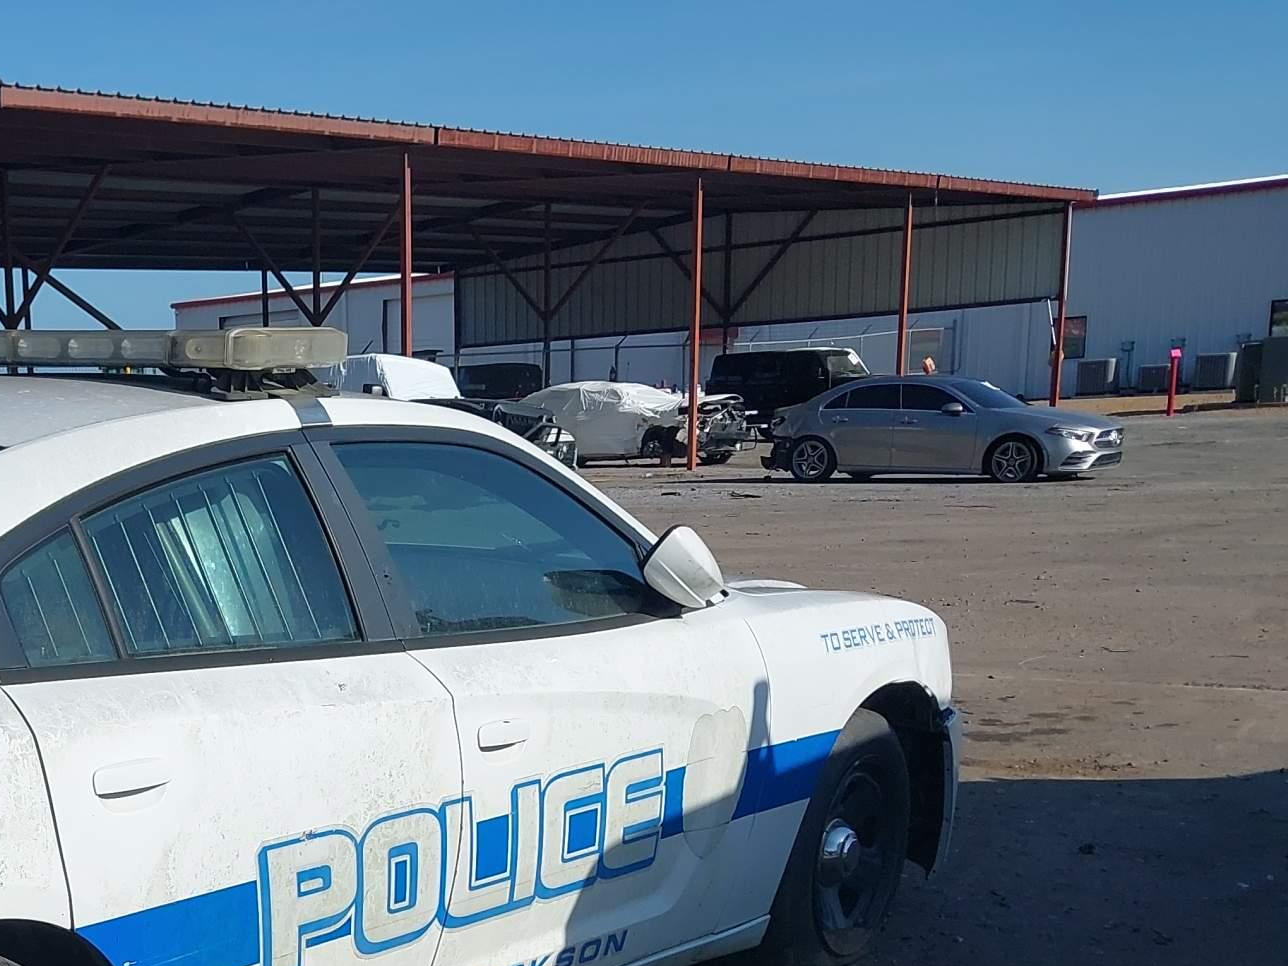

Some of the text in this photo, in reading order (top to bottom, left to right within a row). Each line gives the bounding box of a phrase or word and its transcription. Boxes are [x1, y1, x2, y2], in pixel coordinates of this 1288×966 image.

[821, 618, 936, 653] TO SERVE & PROTECT
